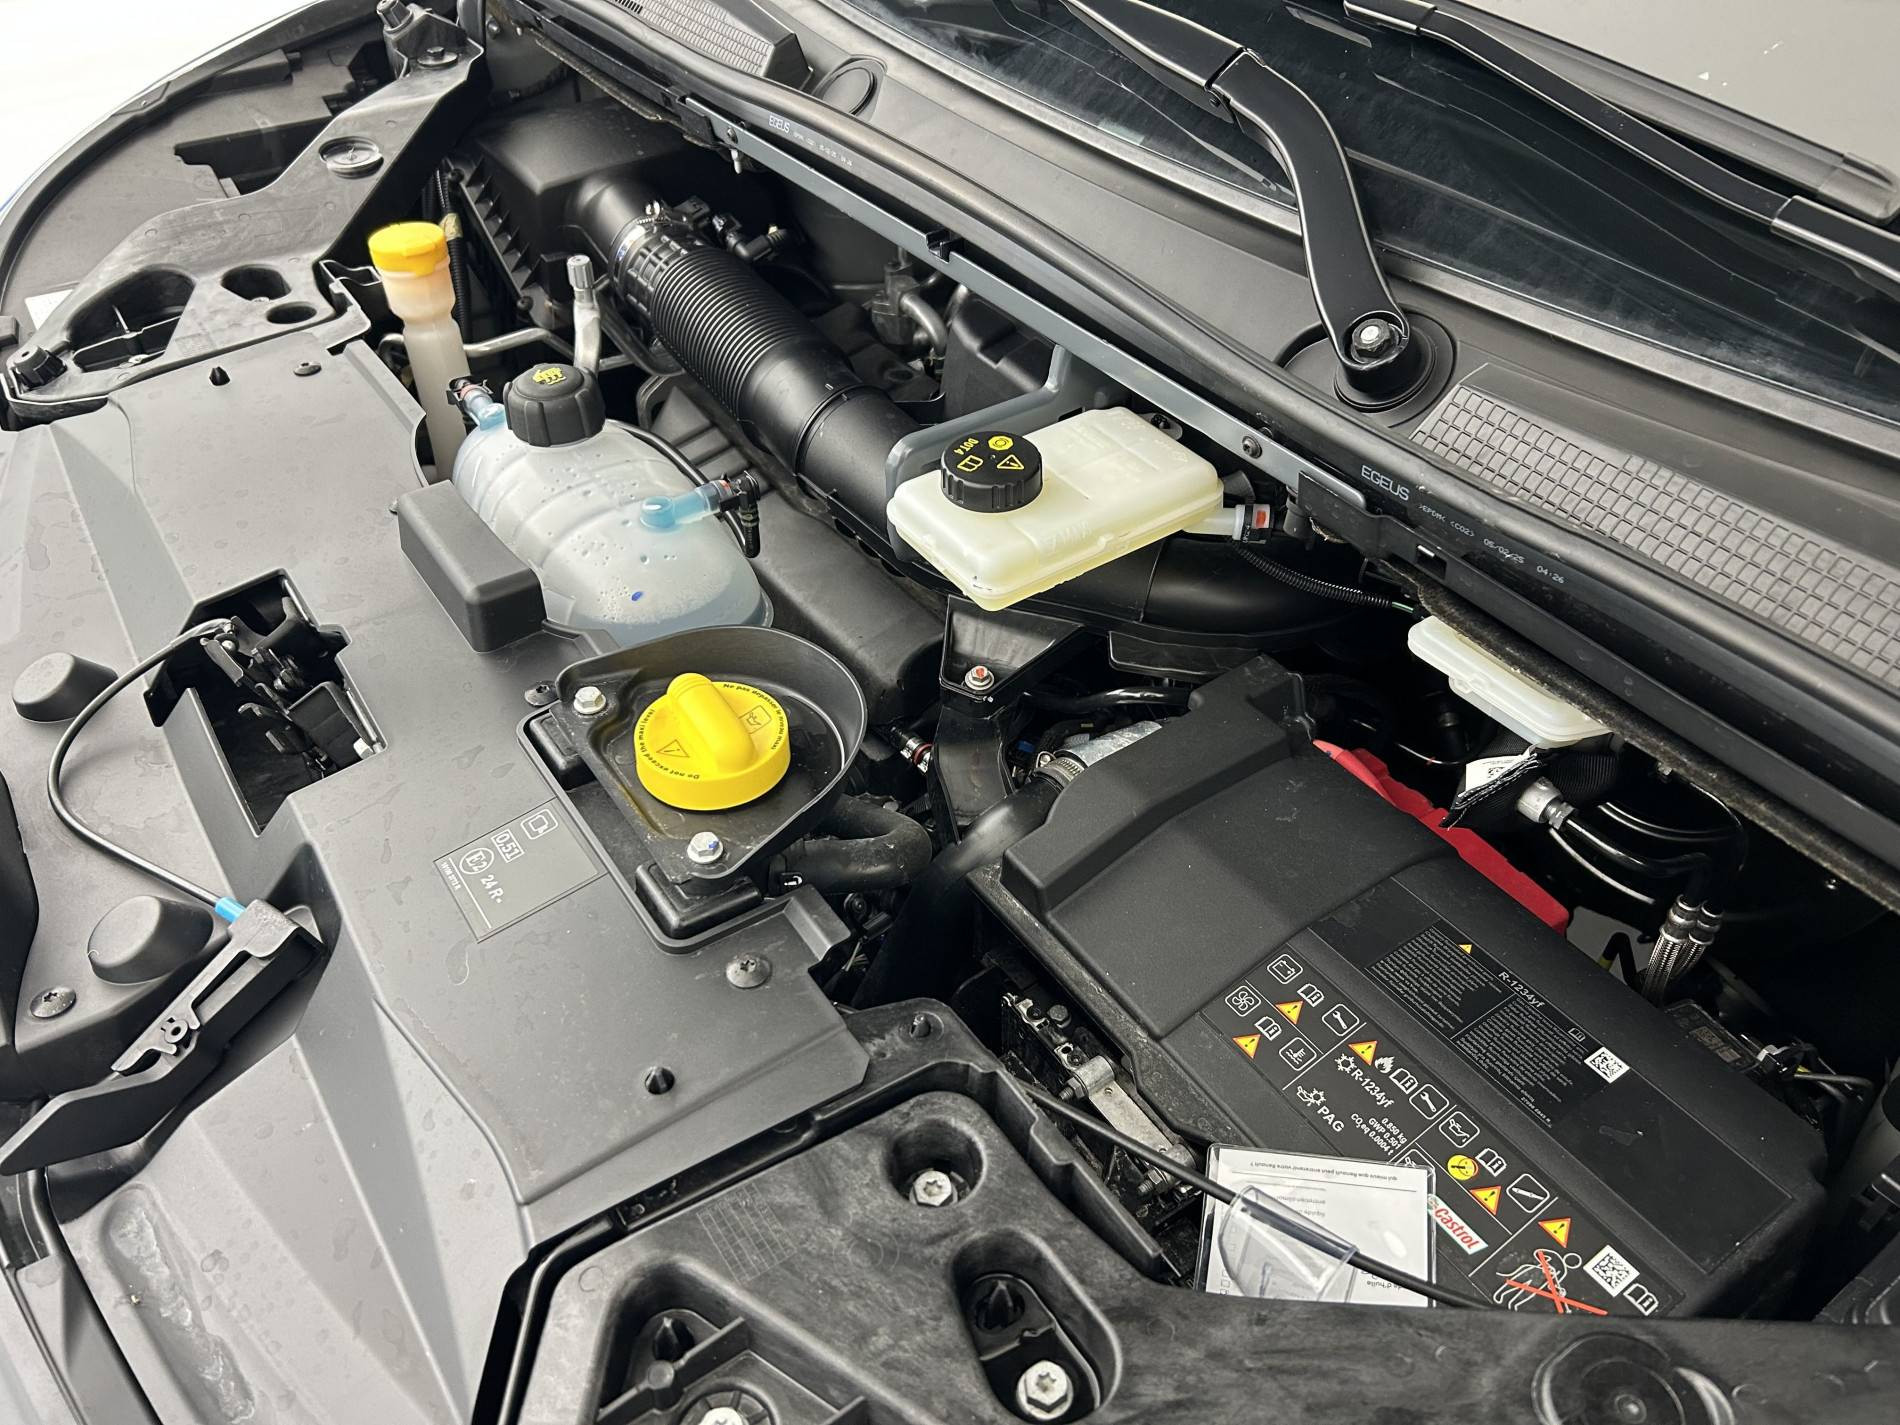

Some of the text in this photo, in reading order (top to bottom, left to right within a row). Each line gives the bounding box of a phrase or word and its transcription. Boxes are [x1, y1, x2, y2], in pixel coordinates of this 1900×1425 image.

[769, 115, 790, 133] EGEUS
[960, 438, 979, 451] DOT
[1361, 465, 1410, 501] EGEUS
[638, 724, 646, 741] maxi
[640, 742, 648, 753] the
[643, 751, 669, 771] exceed
[465, 850, 487, 872] E2
[1498, 971, 1546, 1007] R-1234yf
[1351, 1069, 1395, 1108] R-1234yf
[1317, 1105, 1345, 1132] PAG
[1381, 1117, 1408, 1144] 0.850 kg
[1368, 1117, 1402, 1150] GWP 0.501
[1368, 1130, 1391, 1152] 0.0004
[1435, 1208, 1480, 1250] Castrol
